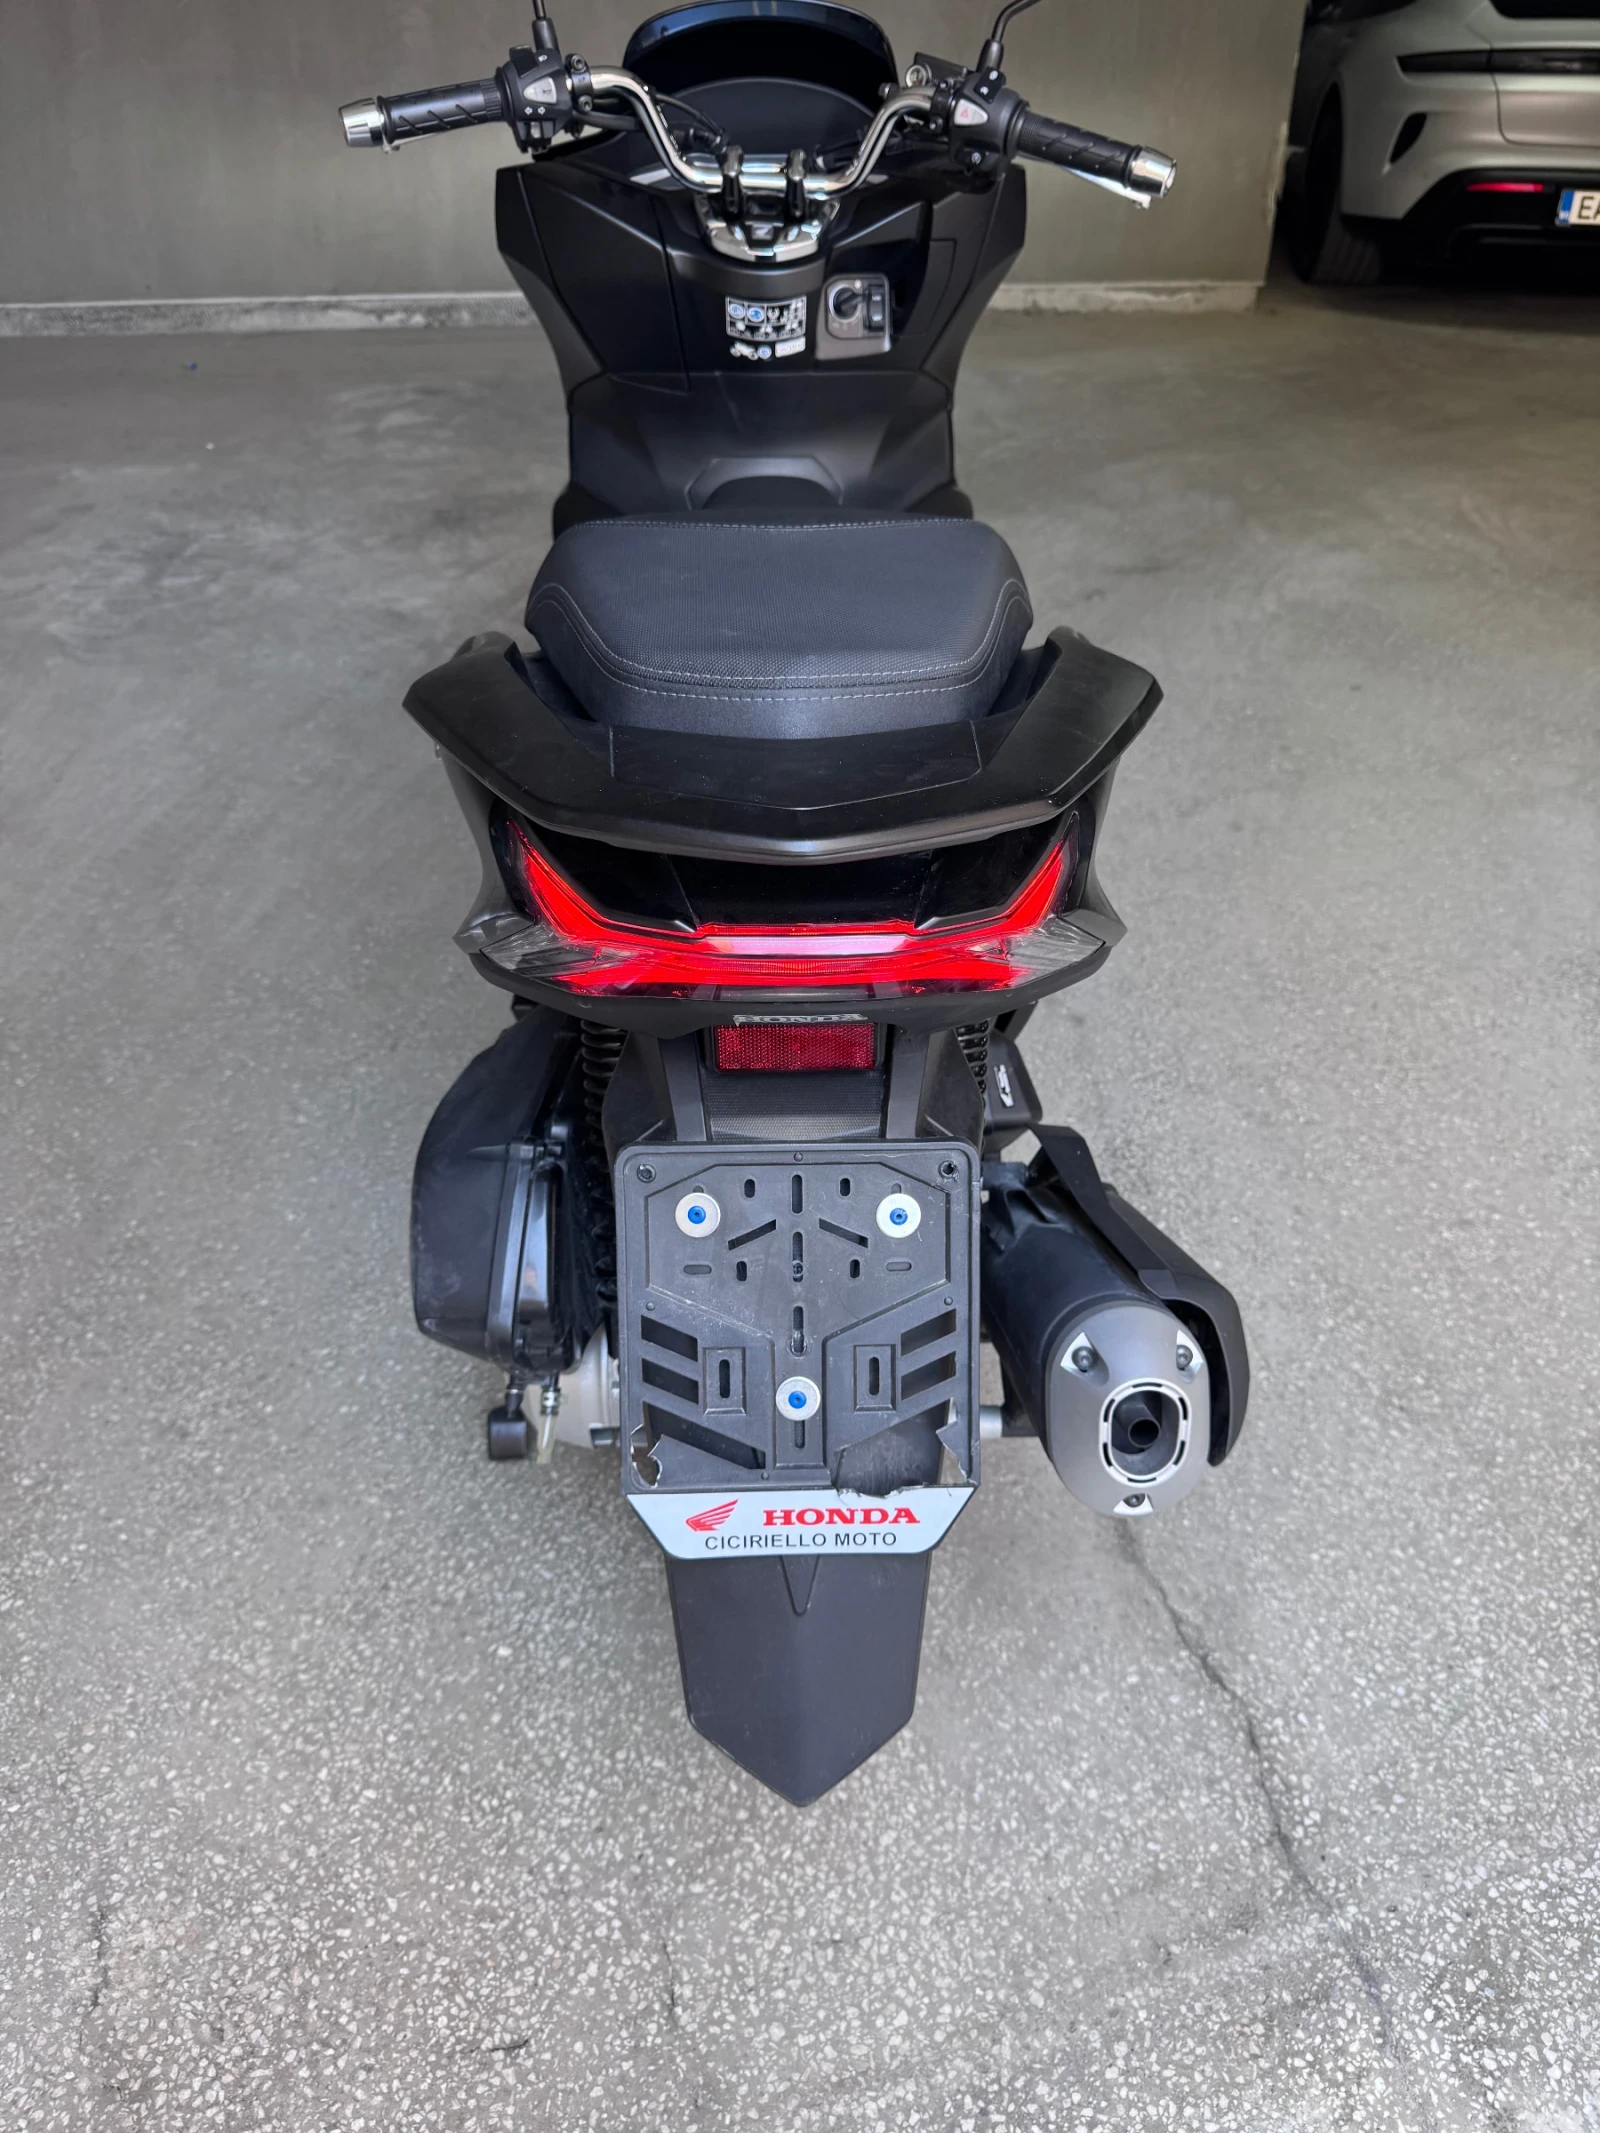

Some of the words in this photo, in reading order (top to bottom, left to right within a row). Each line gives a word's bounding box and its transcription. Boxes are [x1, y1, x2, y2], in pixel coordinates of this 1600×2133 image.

[762, 1507, 920, 1526] HONDA
[705, 1533, 827, 1550] CICIRIELLO
[834, 1532, 897, 1547] MOTO
